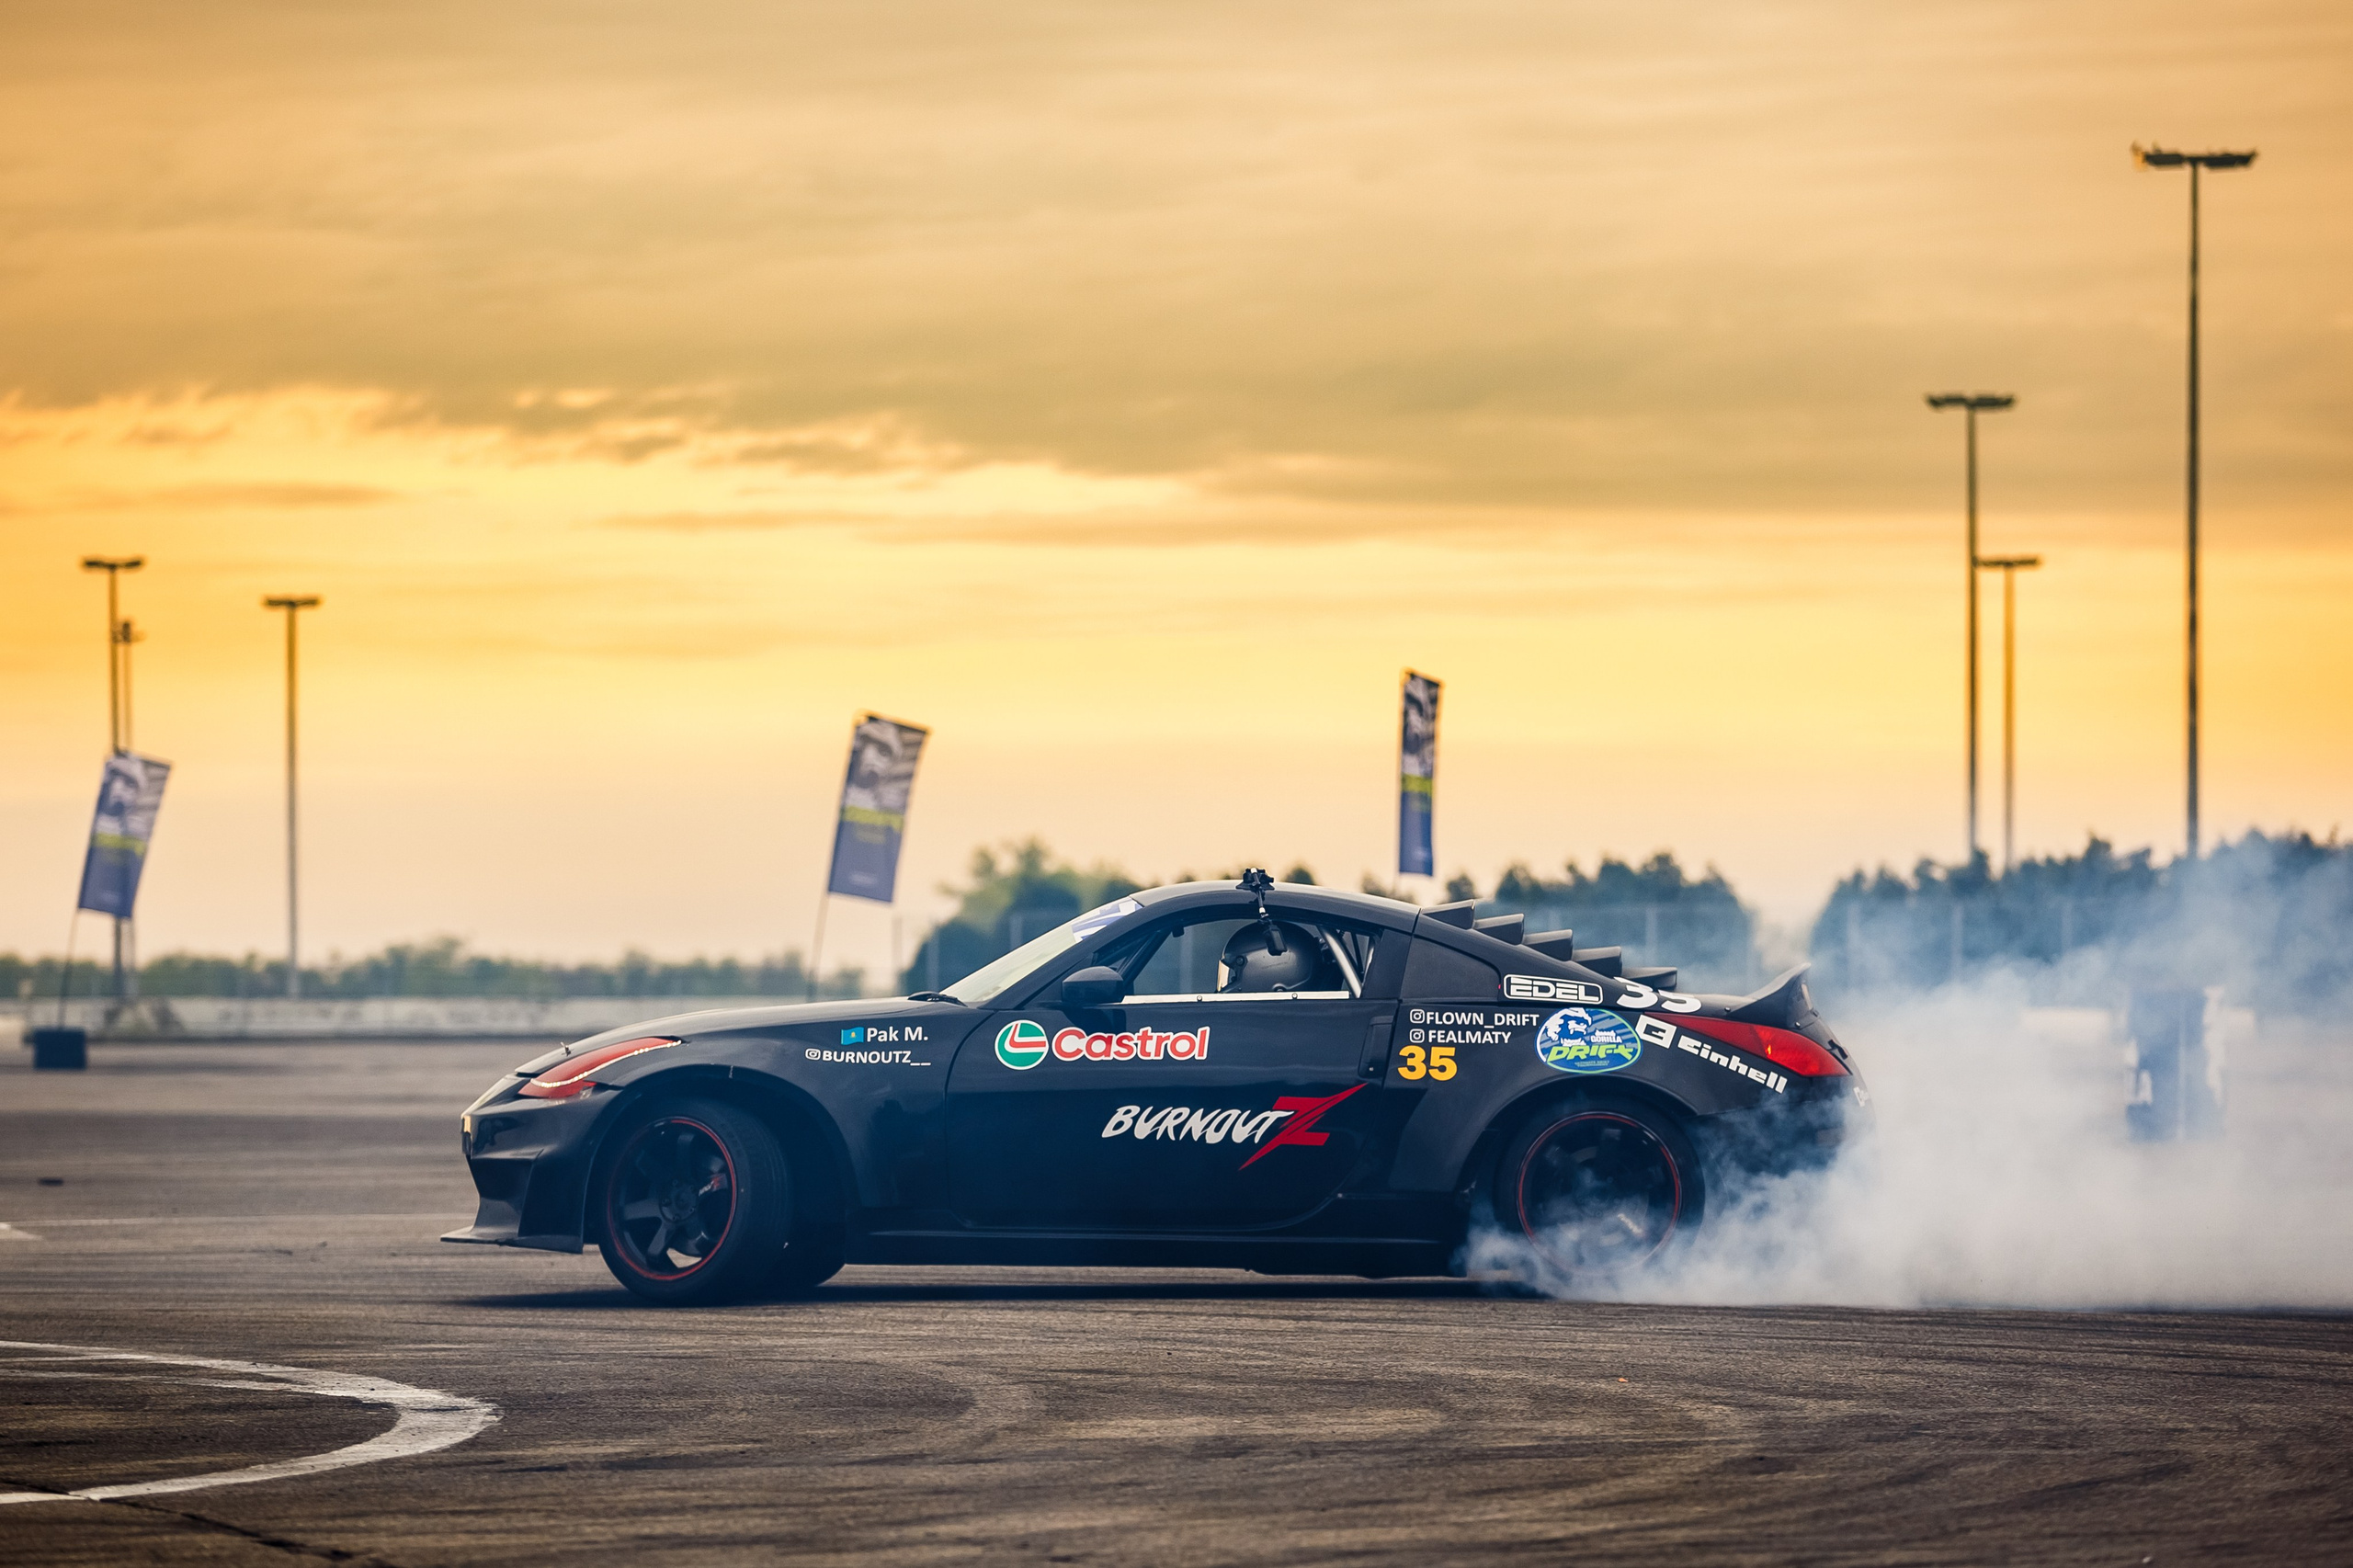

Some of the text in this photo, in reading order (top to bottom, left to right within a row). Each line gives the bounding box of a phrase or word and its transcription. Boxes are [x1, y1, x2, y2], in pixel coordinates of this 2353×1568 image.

[1510, 977, 1599, 1002] EDEL
[1427, 1012, 1540, 1028] FLOWN_DRIFT
[867, 1026, 928, 1042] Pak M.
[1428, 1030, 1512, 1044] FEALMATY
[1590, 1035, 1622, 1043] GORILLA
[1052, 1027, 1211, 1062] Castrol
[1547, 1044, 1633, 1062] DRIFT
[1397, 1045, 1458, 1082] 35
